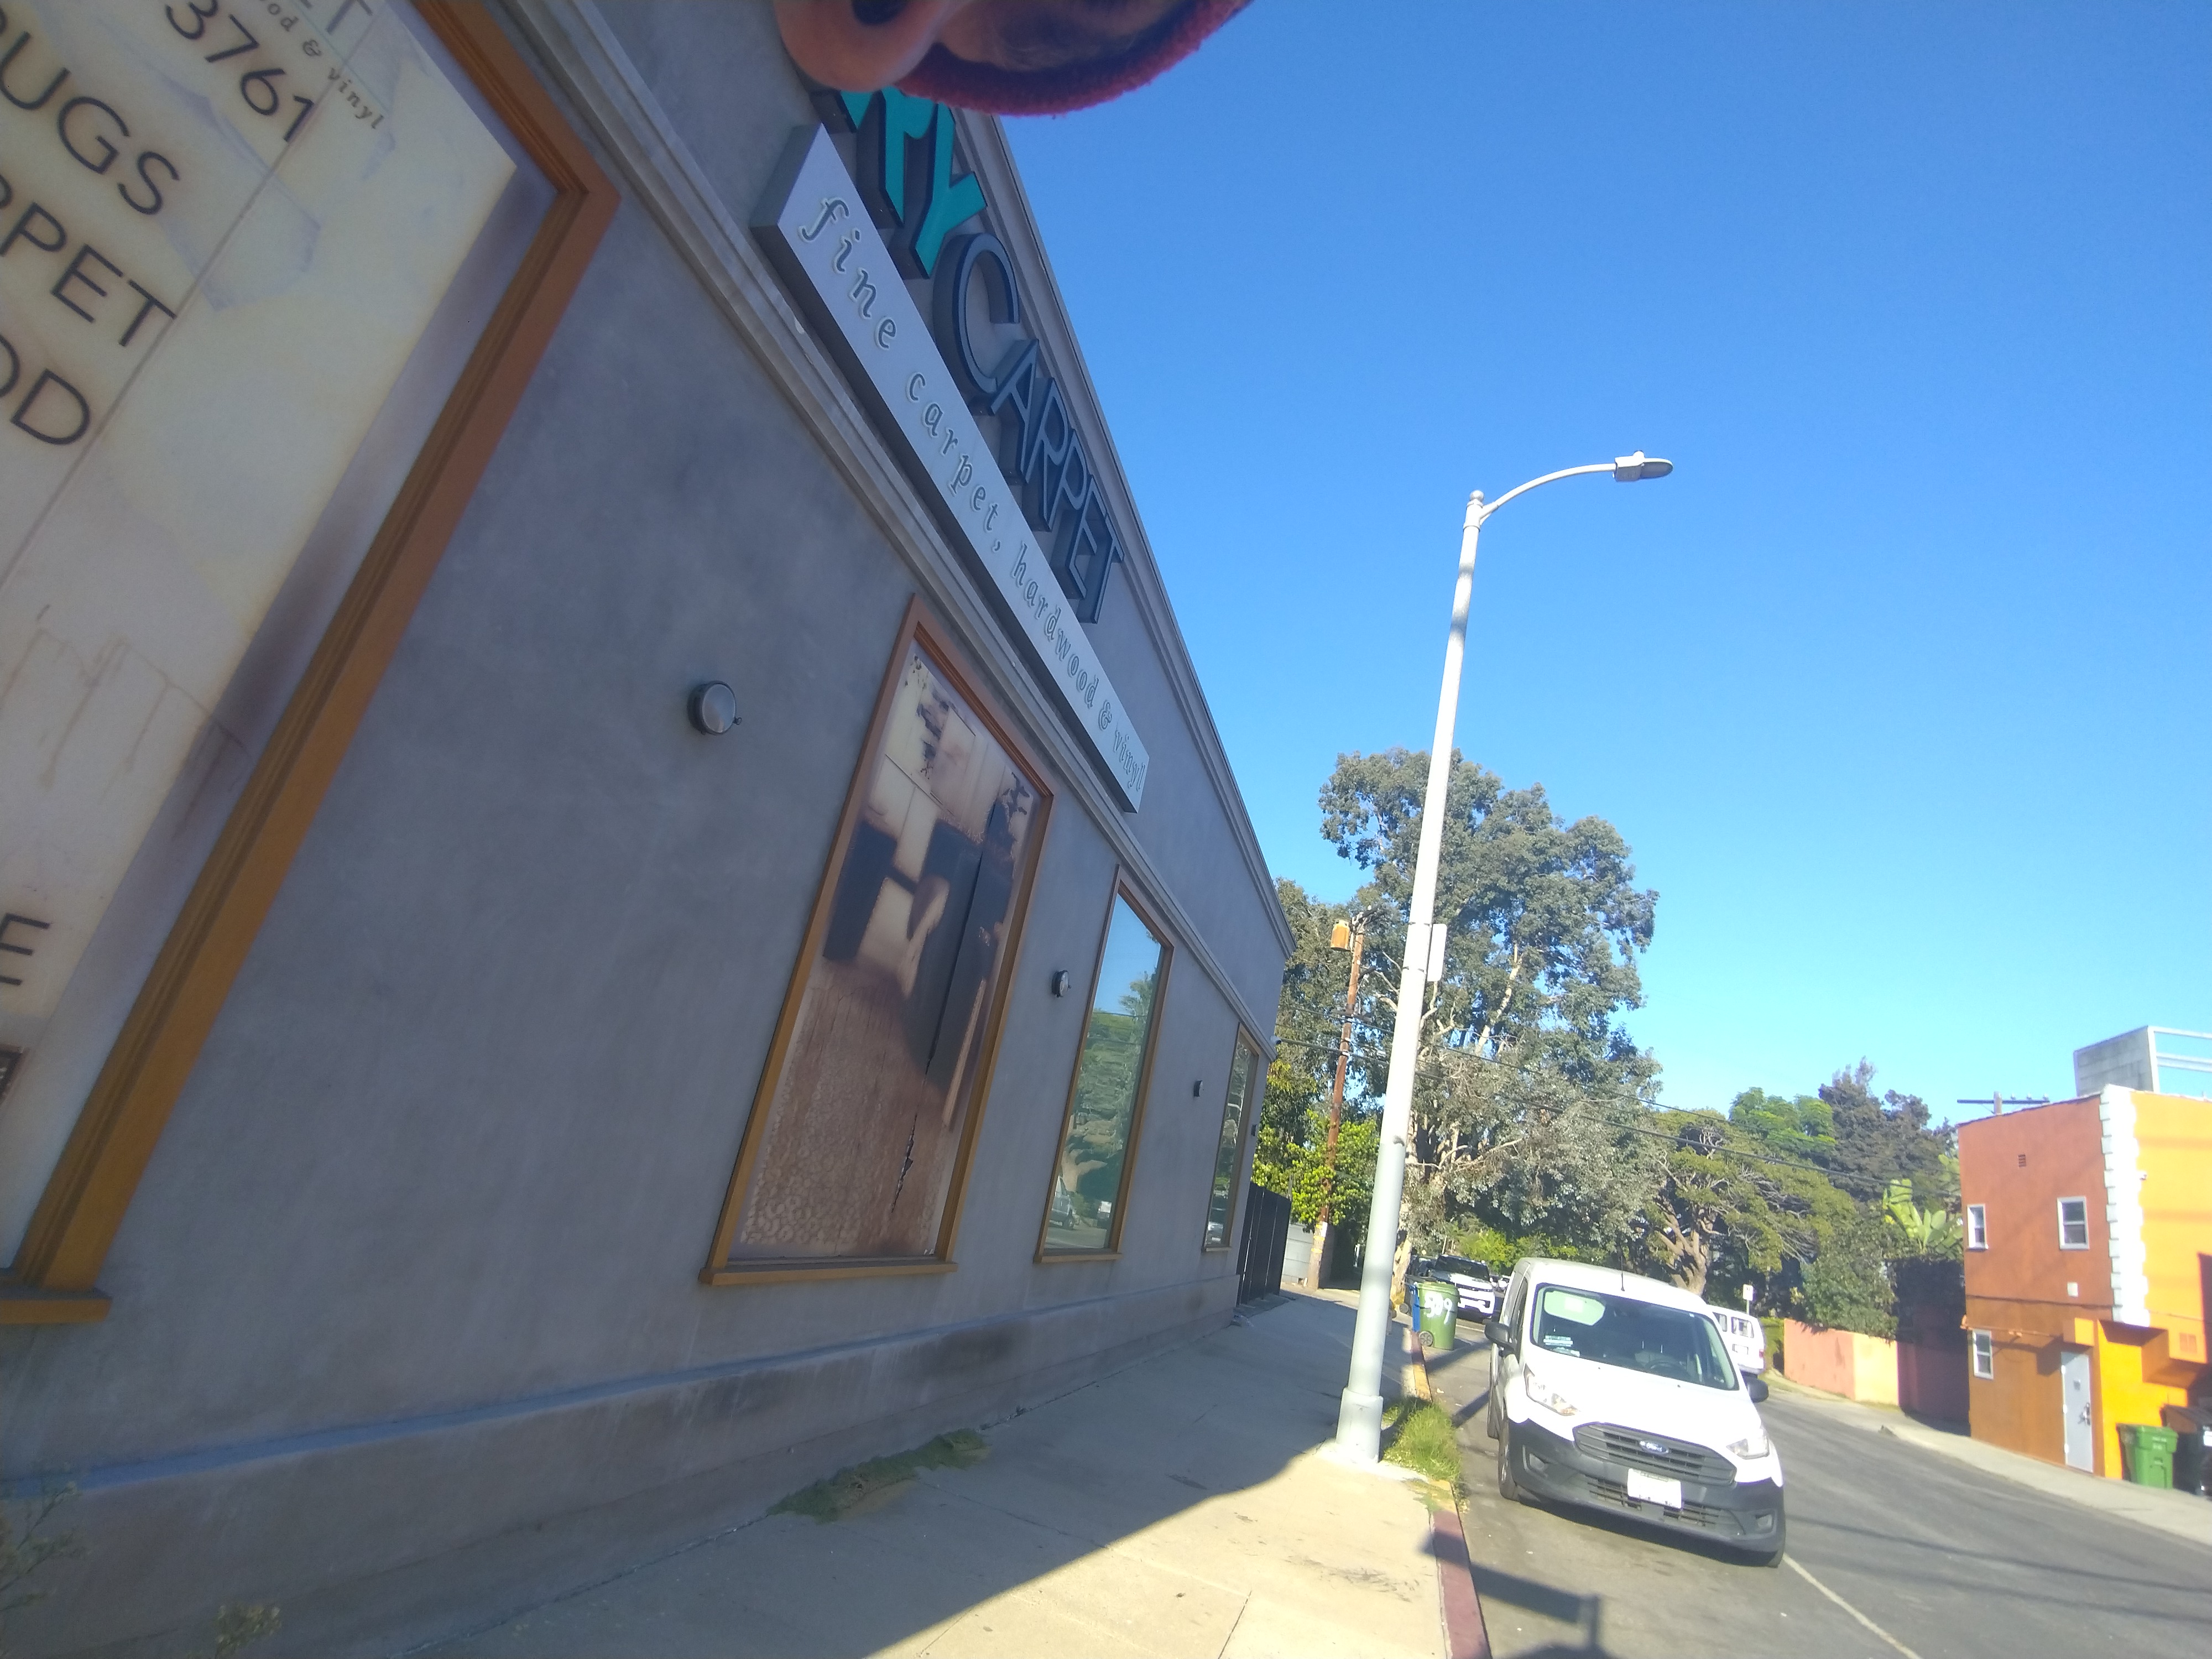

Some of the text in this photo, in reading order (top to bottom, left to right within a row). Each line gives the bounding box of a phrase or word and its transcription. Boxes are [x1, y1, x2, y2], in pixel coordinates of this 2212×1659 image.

[0, 6, 181, 216] UGS
[302, 39, 322, 56] &
[327, 67, 385, 130] vinyl
[800, 197, 1146, 792] fine carpet, hardwood & vinyl
[941, 231, 1125, 624] CARPET
